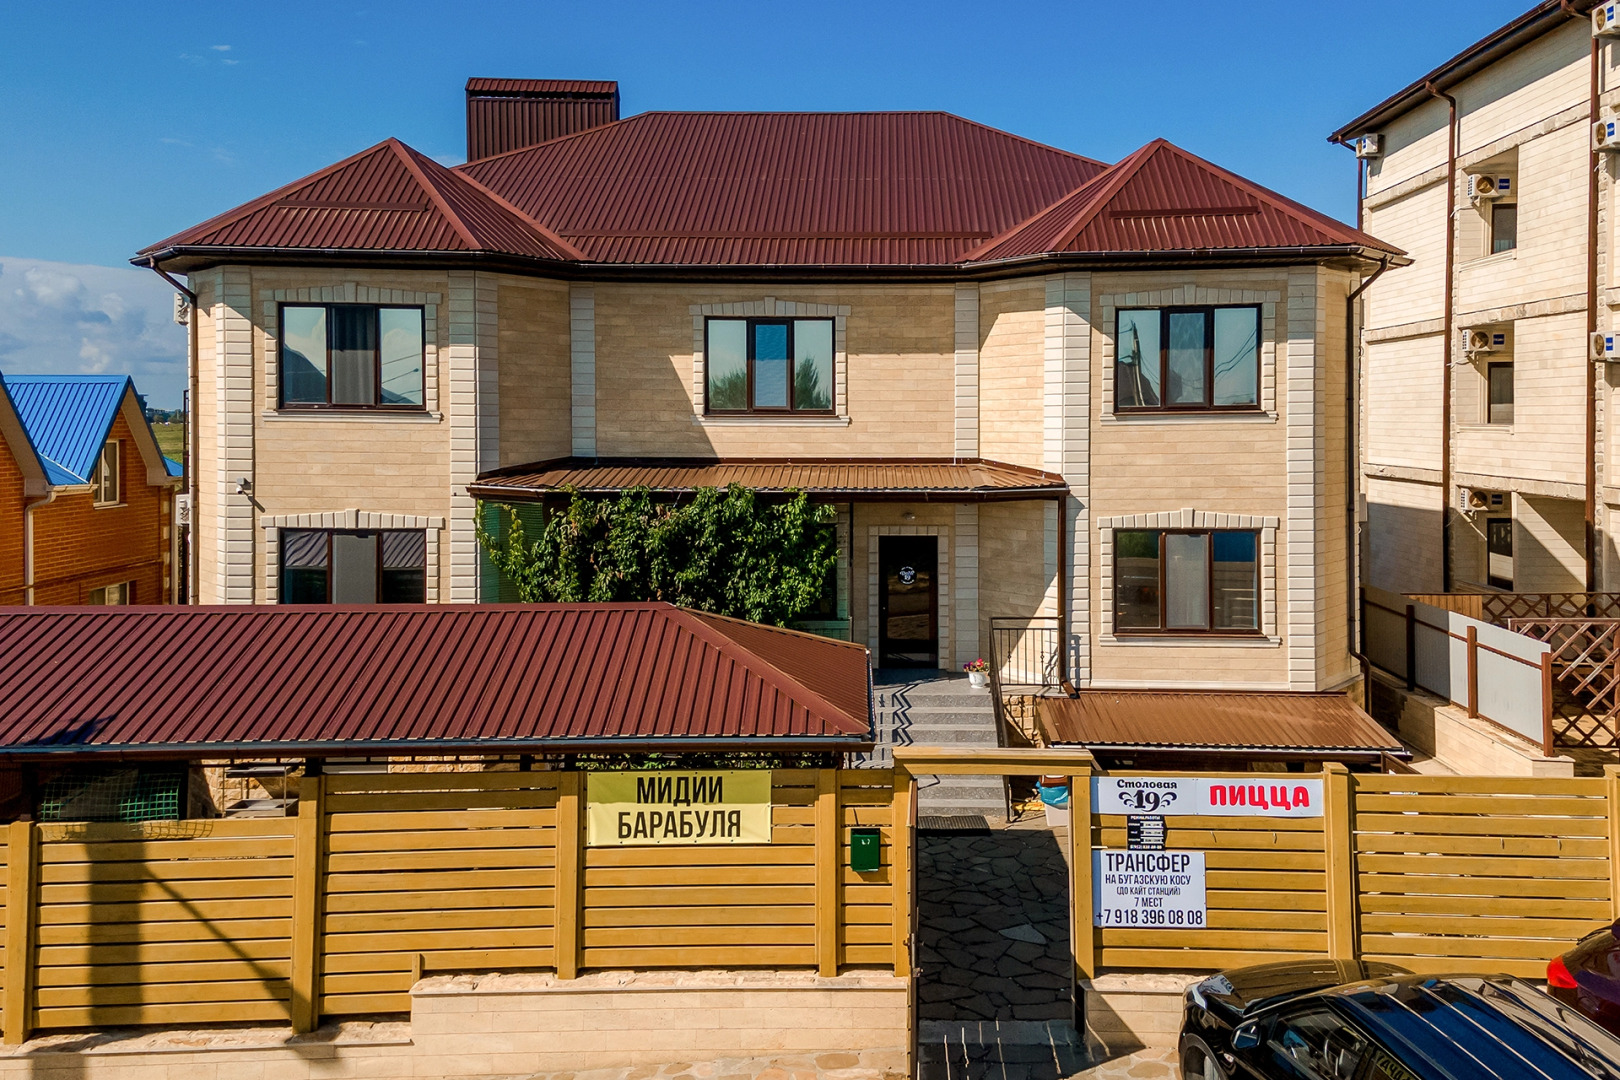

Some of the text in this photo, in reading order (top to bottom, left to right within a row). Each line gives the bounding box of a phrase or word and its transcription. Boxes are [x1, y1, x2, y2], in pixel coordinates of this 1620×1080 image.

[636, 776, 723, 807] МИДИИ
[1116, 778, 1178, 789] Столовая
[1132, 790, 1161, 812] 19
[1209, 785, 1310, 810] ПИЦЦА
[618, 810, 741, 839] БАРАБУЛЯ
[1105, 853, 1190, 873] ТРАНСФЕР
[1105, 874, 1191, 885] НА БУГАЗСКУЮ КОСУ
[1116, 886, 1181, 896] (ДО КАЙТ СТАНЦИЙ)
[1134, 897, 1163, 907] 7 МЕСТ
[1096, 909, 1203, 925] +7 918 396 08 08
